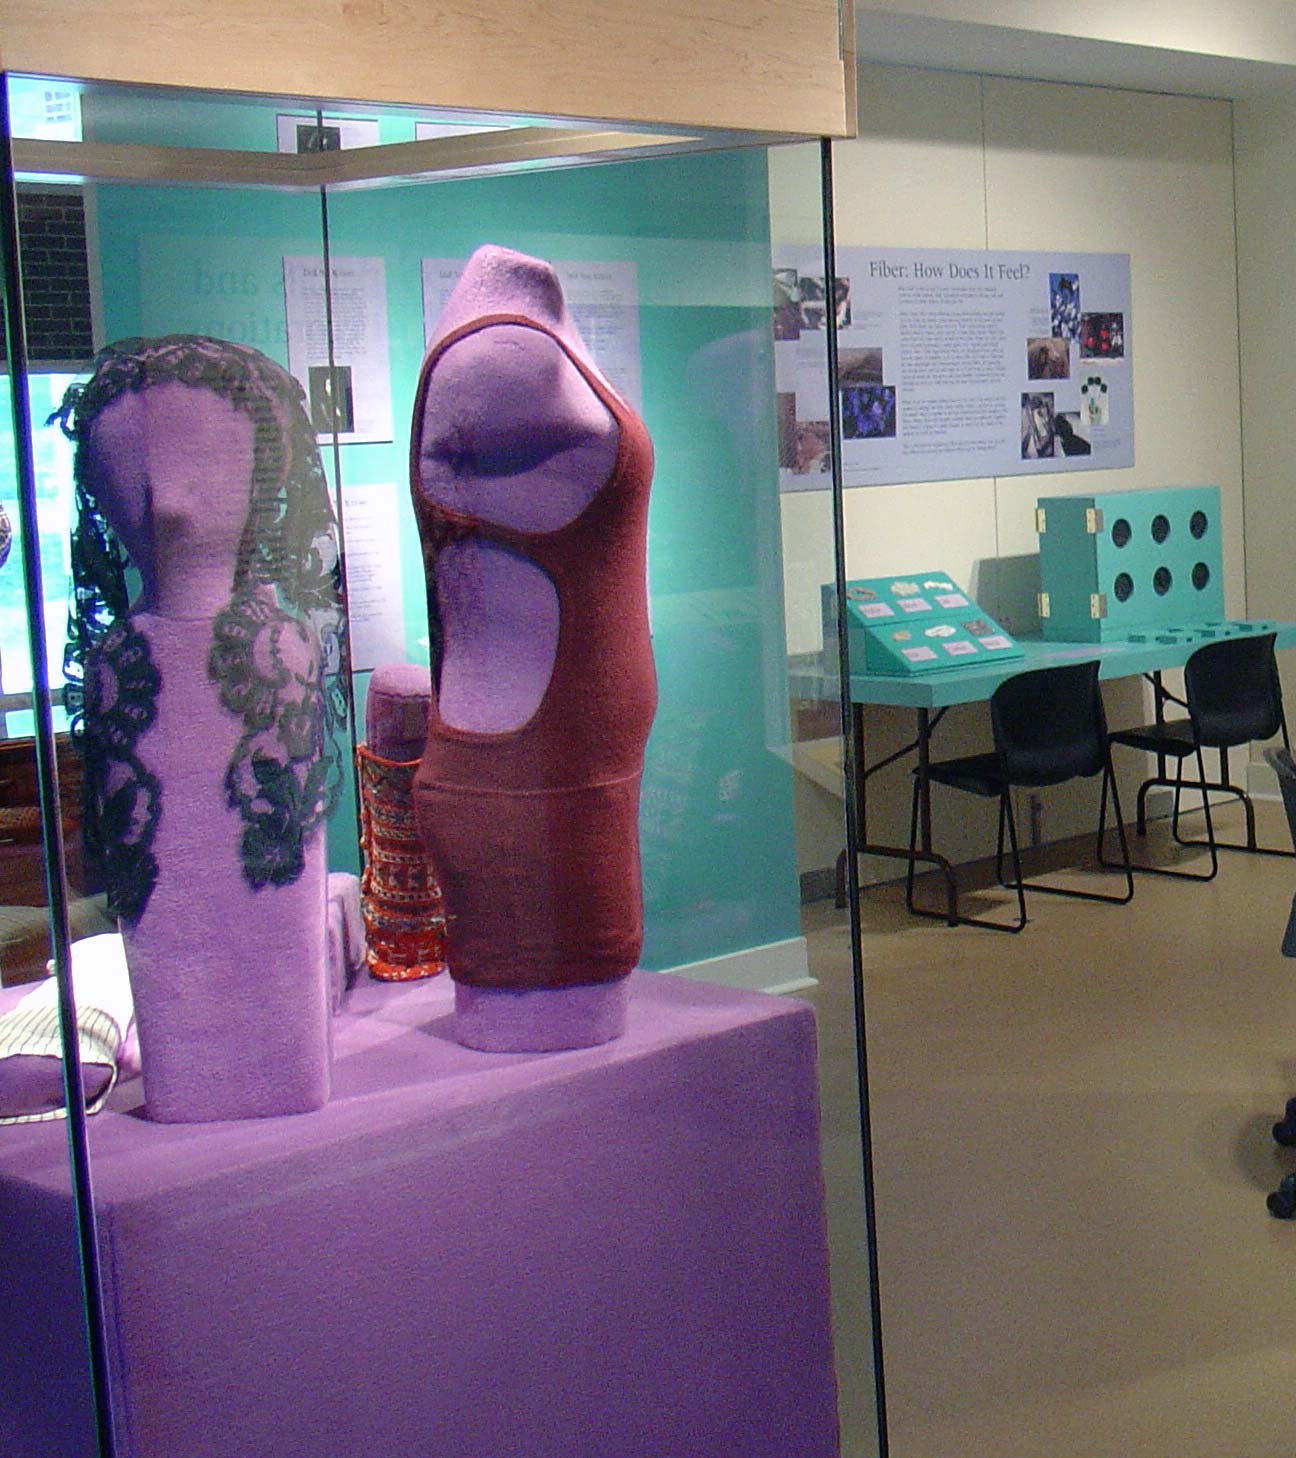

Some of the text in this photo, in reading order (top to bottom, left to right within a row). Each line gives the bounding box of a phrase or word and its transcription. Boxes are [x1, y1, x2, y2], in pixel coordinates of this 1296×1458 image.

[869, 260, 1031, 280] Fiber: How Does It Feel?
